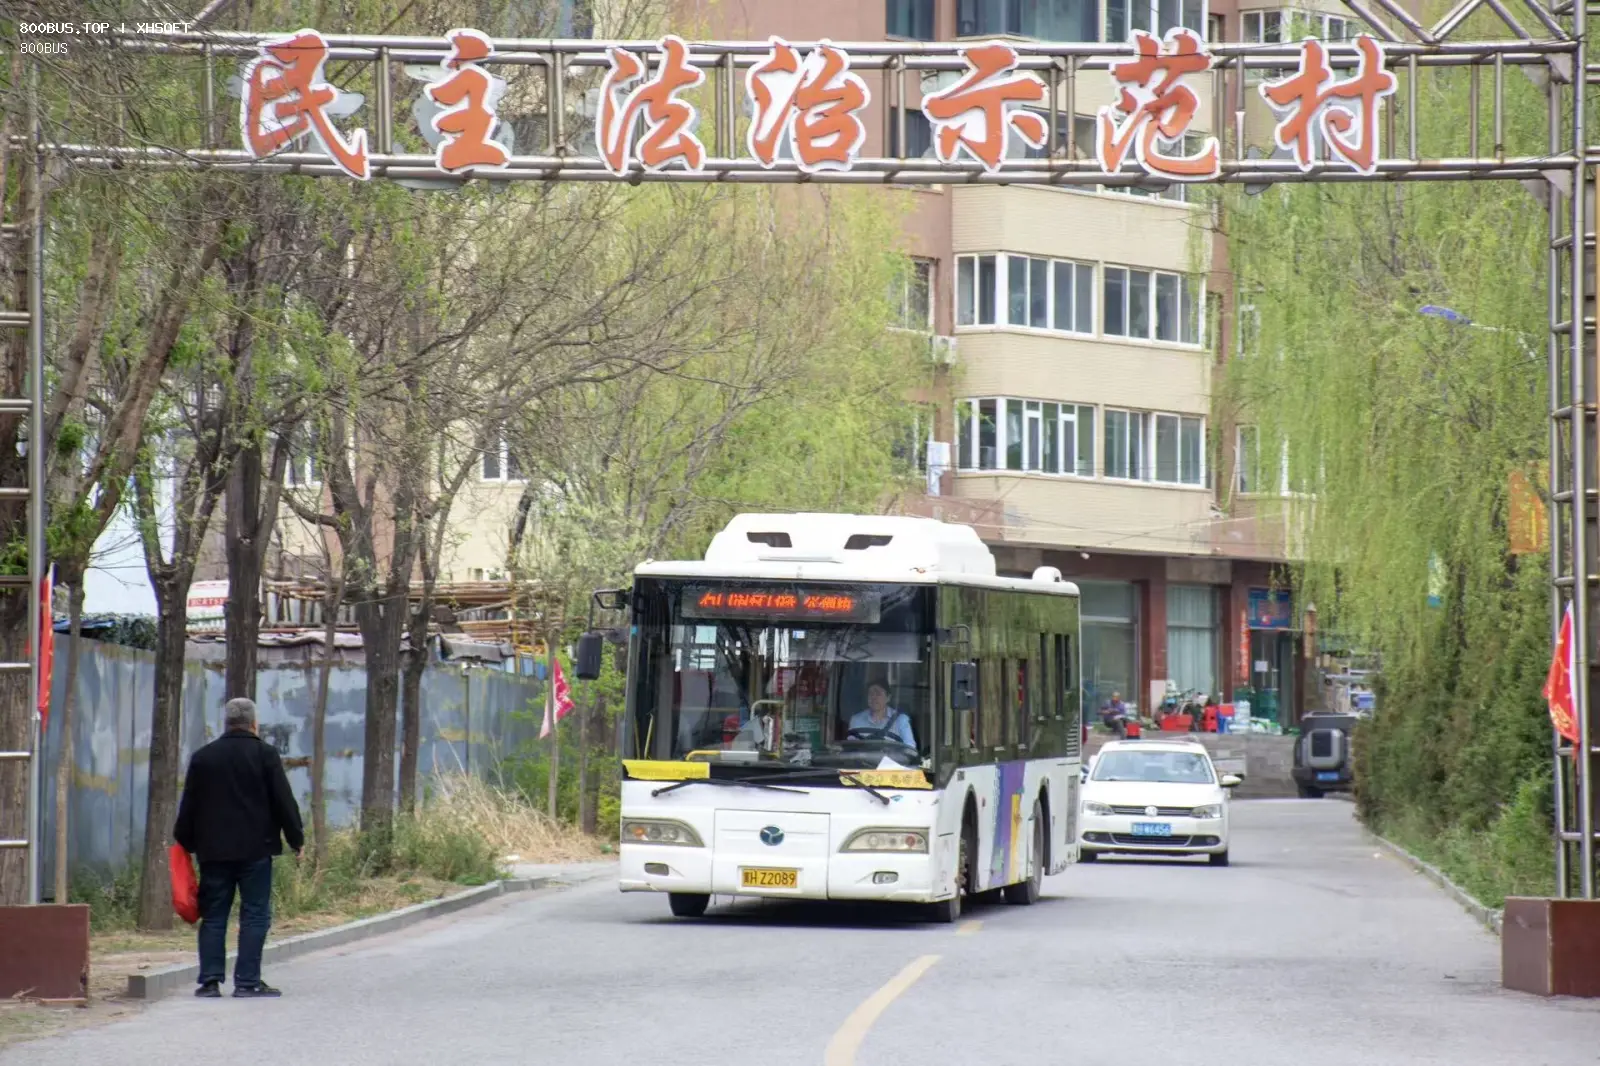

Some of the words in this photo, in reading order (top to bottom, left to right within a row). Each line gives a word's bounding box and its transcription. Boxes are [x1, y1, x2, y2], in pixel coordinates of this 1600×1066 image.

[241, 28, 1398, 182] 民主法治示范村
